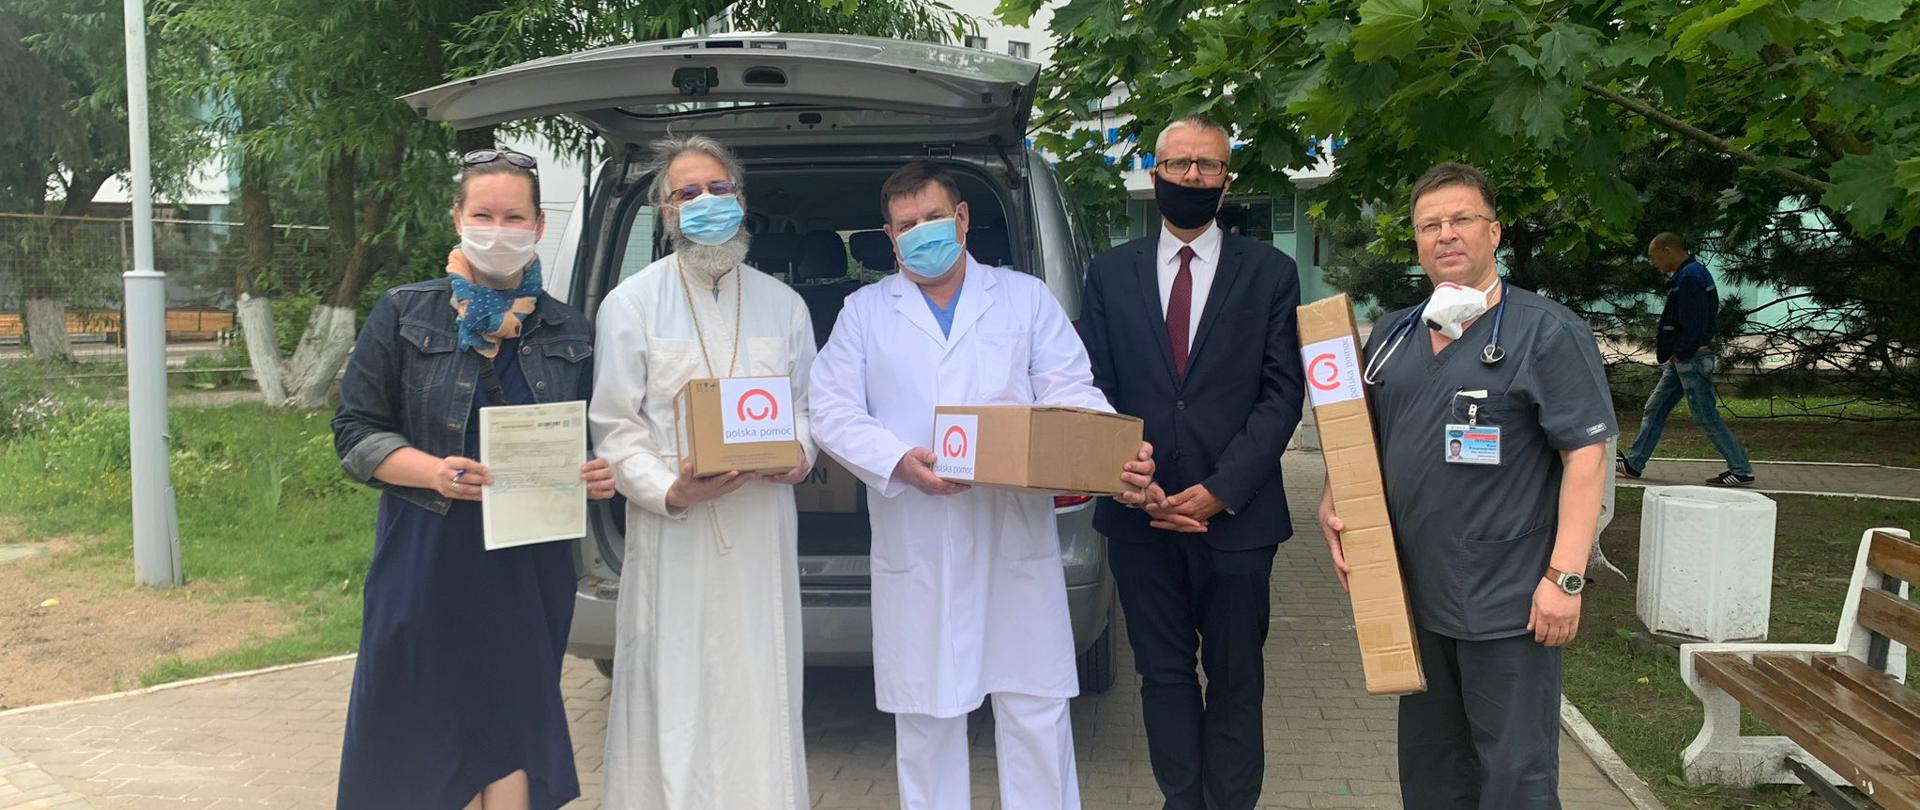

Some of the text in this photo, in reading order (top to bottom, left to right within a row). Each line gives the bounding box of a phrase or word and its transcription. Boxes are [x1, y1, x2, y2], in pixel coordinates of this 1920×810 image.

[1342, 338, 1359, 398] polska pomoc
[725, 426, 792, 439] polska pomoc
